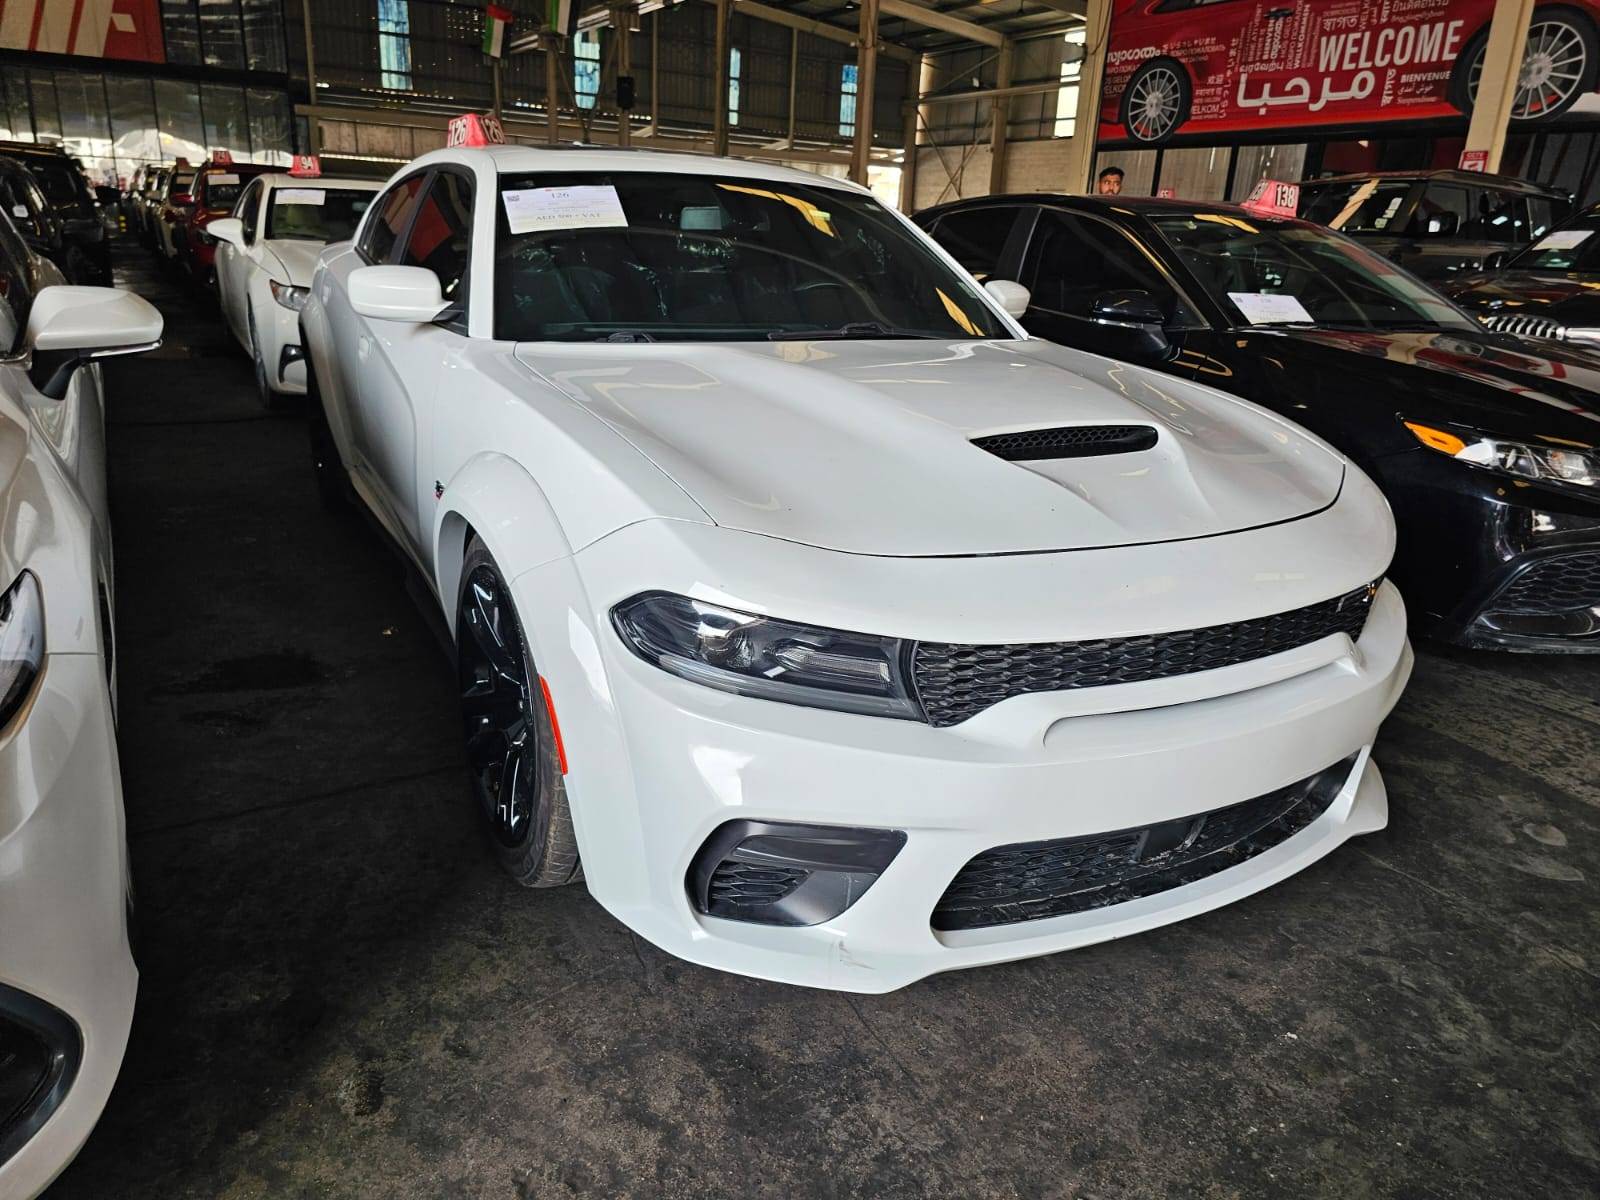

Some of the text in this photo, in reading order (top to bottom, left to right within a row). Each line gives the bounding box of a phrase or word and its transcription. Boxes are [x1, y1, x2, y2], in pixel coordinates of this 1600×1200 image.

[1319, 20, 1464, 72] WELCOME
[1400, 70, 1452, 83] BIENVENUE
[1237, 70, 1375, 116] مرحبا
[450, 119, 466, 146] 126
[301, 156, 314, 169] 94
[1276, 184, 1295, 208] 138
